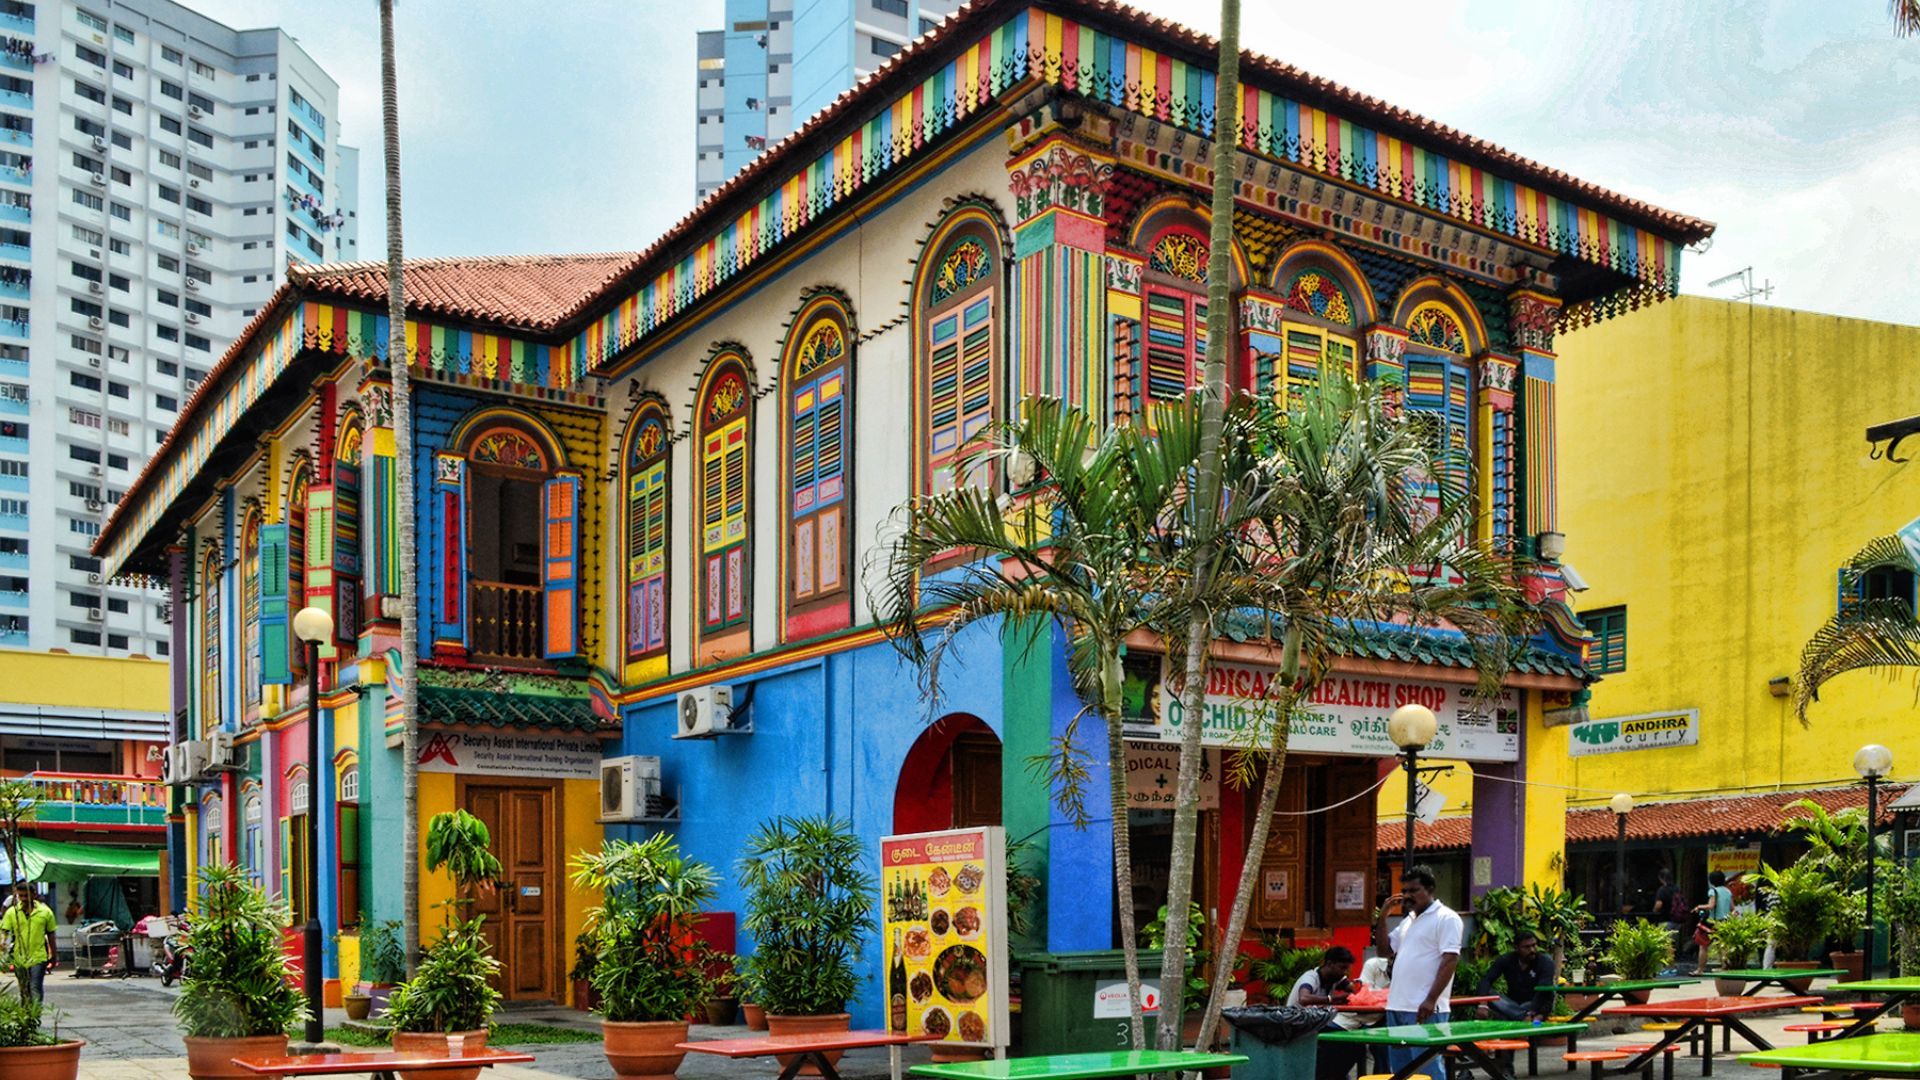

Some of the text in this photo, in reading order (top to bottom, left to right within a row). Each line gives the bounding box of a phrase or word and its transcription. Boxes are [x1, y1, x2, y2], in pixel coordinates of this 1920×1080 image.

[1308, 678, 1390, 708] HEALTH
[1394, 684, 1446, 712] SHOP
[1168, 700, 1246, 731] OCHID
[1309, 725, 1337, 736] CARE
[1625, 718, 1687, 733] ANDHRA
[463, 734, 491, 751] Security
[494, 736, 514, 749] Assist
[516, 738, 555, 752] International
[557, 739, 578, 752] Private
[1624, 730, 1687, 744] curry
[474, 750, 494, 762] Security
[497, 752, 511, 761] Assist
[513, 754, 542, 763] International
[544, 754, 562, 765] Training
[1117, 1022, 1129, 1046] 3
